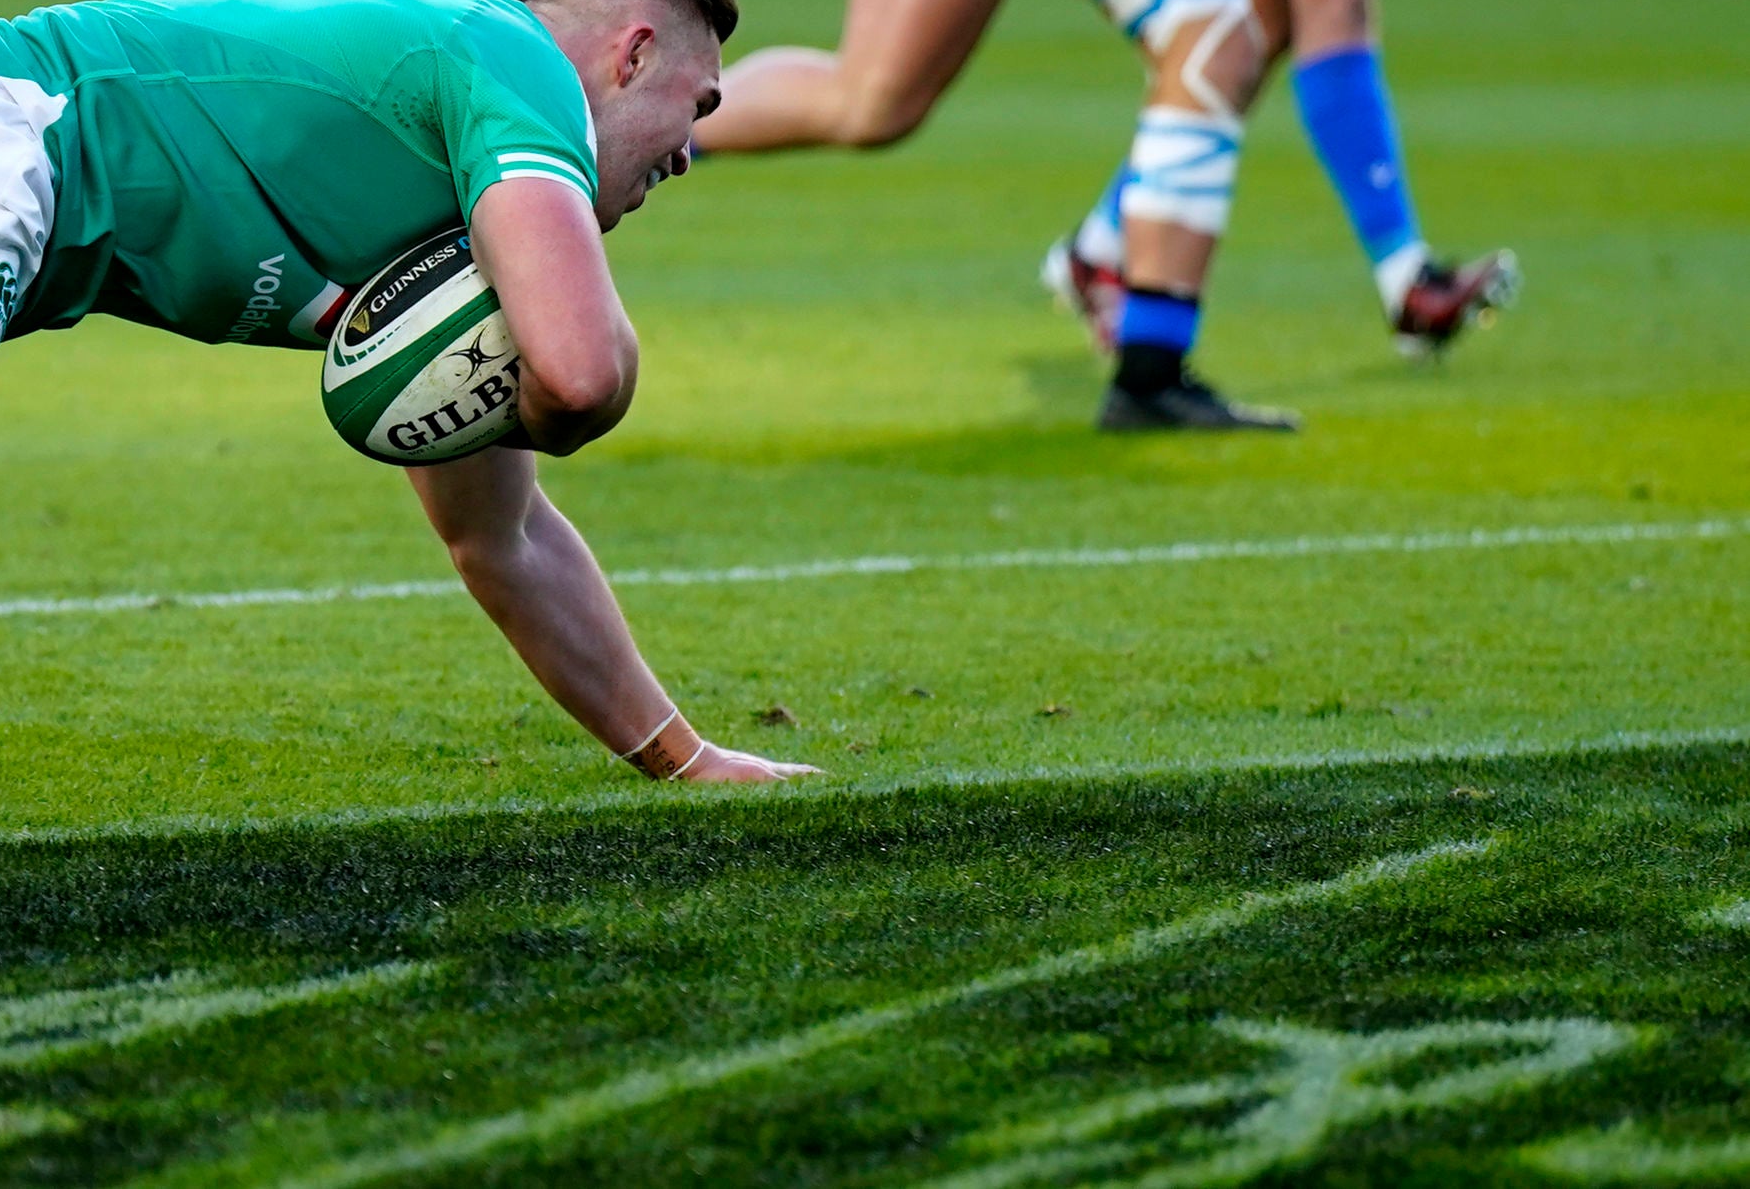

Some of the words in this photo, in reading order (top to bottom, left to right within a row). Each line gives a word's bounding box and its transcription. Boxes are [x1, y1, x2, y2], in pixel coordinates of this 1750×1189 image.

[226, 252, 285, 343] vodafon
[370, 243, 458, 314] GUINNESS
[387, 355, 520, 451] GILB
